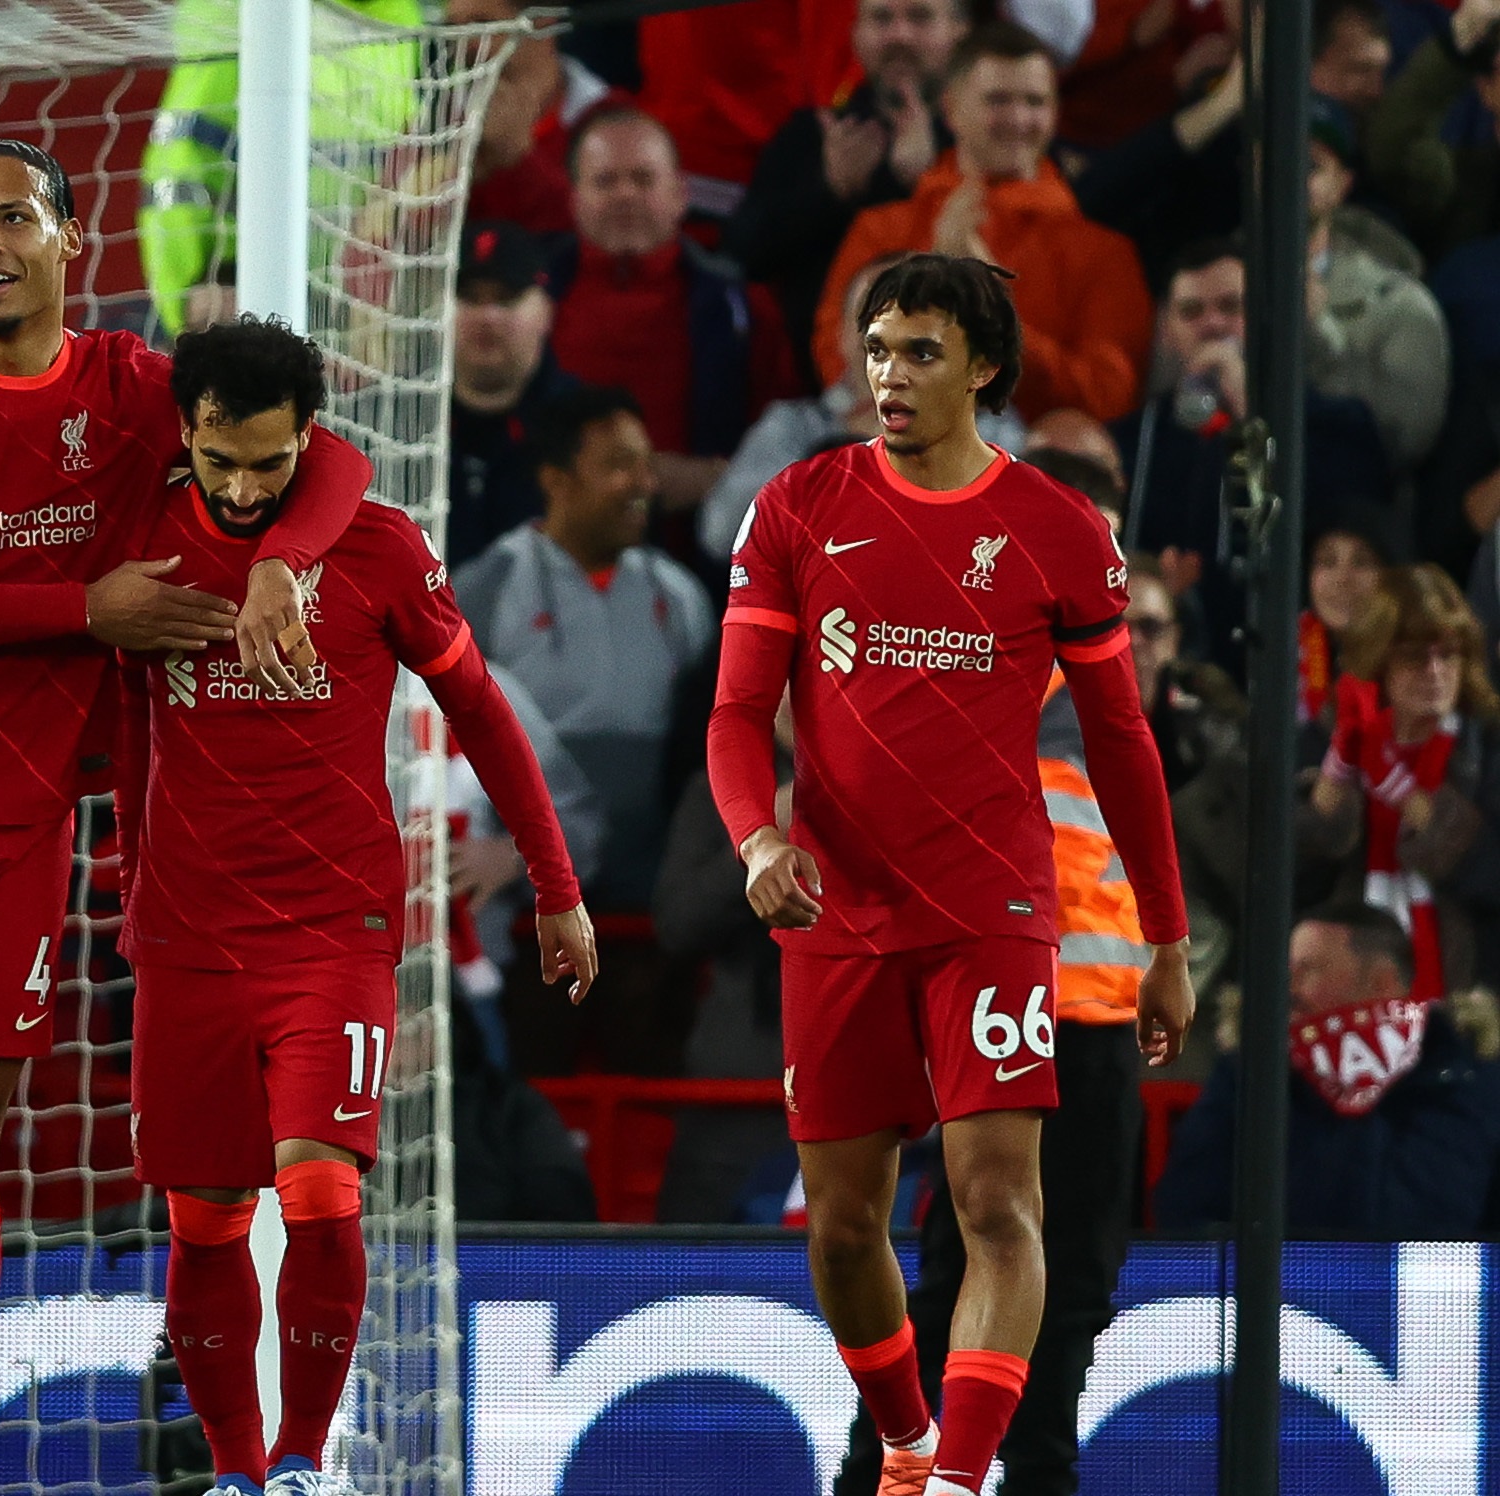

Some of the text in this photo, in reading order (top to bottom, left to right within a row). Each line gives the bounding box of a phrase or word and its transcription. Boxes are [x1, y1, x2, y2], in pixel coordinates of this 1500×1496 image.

[865, 644, 993, 672] chartered
[867, 620, 994, 653] standard
[24, 936, 50, 1005] 4
[971, 985, 1055, 1060] 66
[343, 1022, 385, 1099] 11
